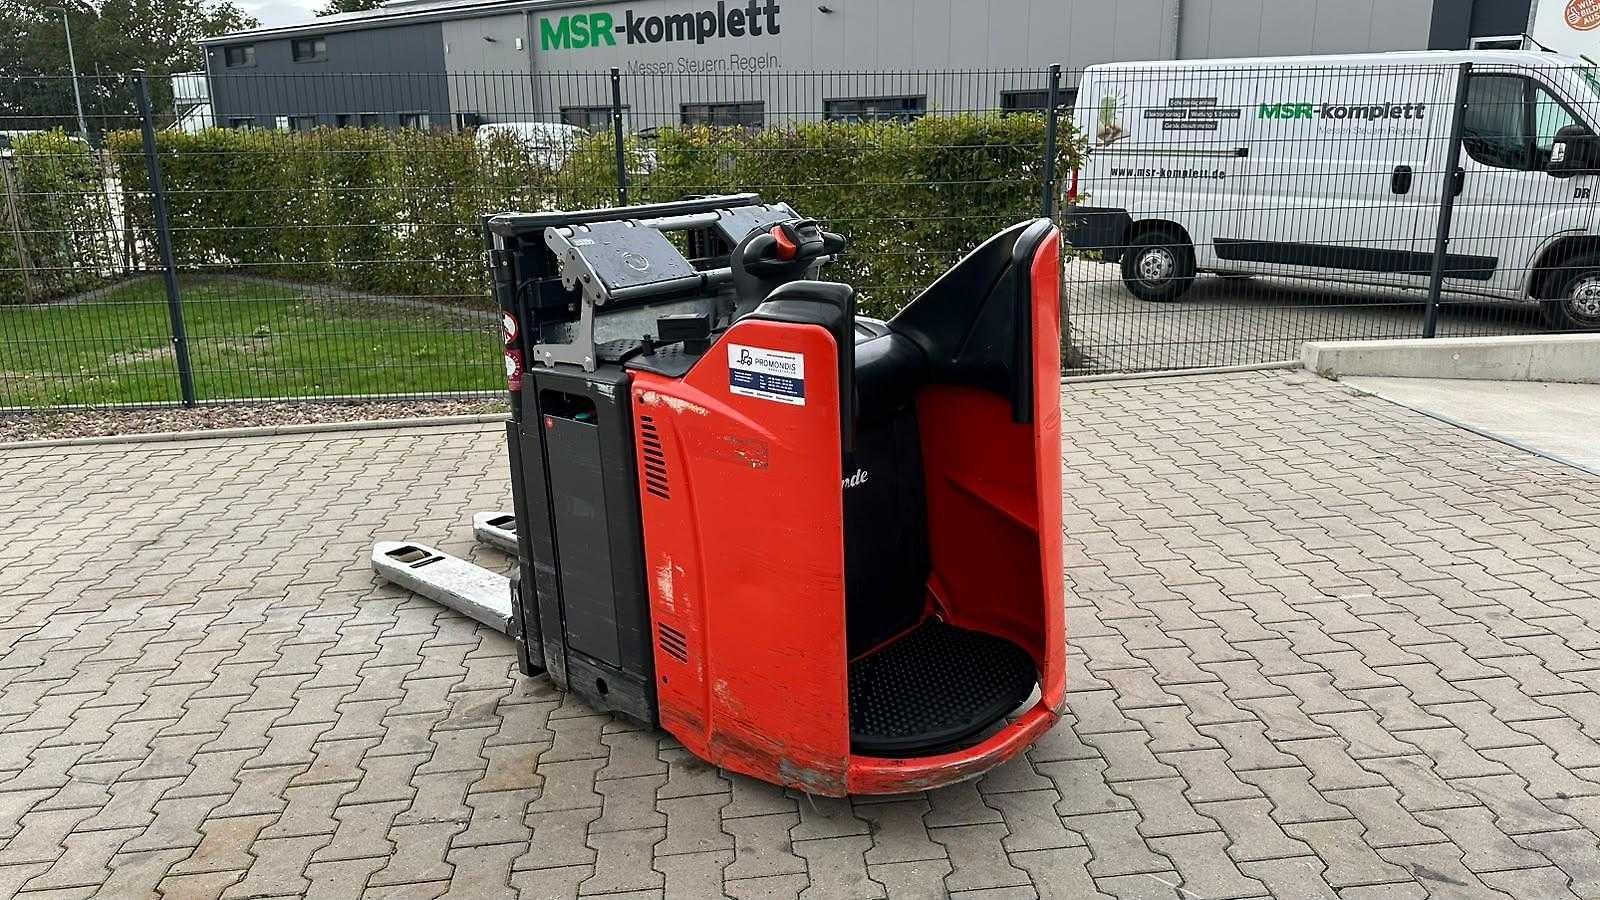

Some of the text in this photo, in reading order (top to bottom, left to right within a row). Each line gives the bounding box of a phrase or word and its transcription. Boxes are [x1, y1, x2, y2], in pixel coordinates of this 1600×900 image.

[539, 0, 781, 50] MSR-komplett
[1257, 101, 1425, 121] MSR-komplett
[1110, 167, 1226, 179] www.msr-komplett.de
[754, 358, 796, 371] PROMONDIS
[841, 468, 869, 489] nde
